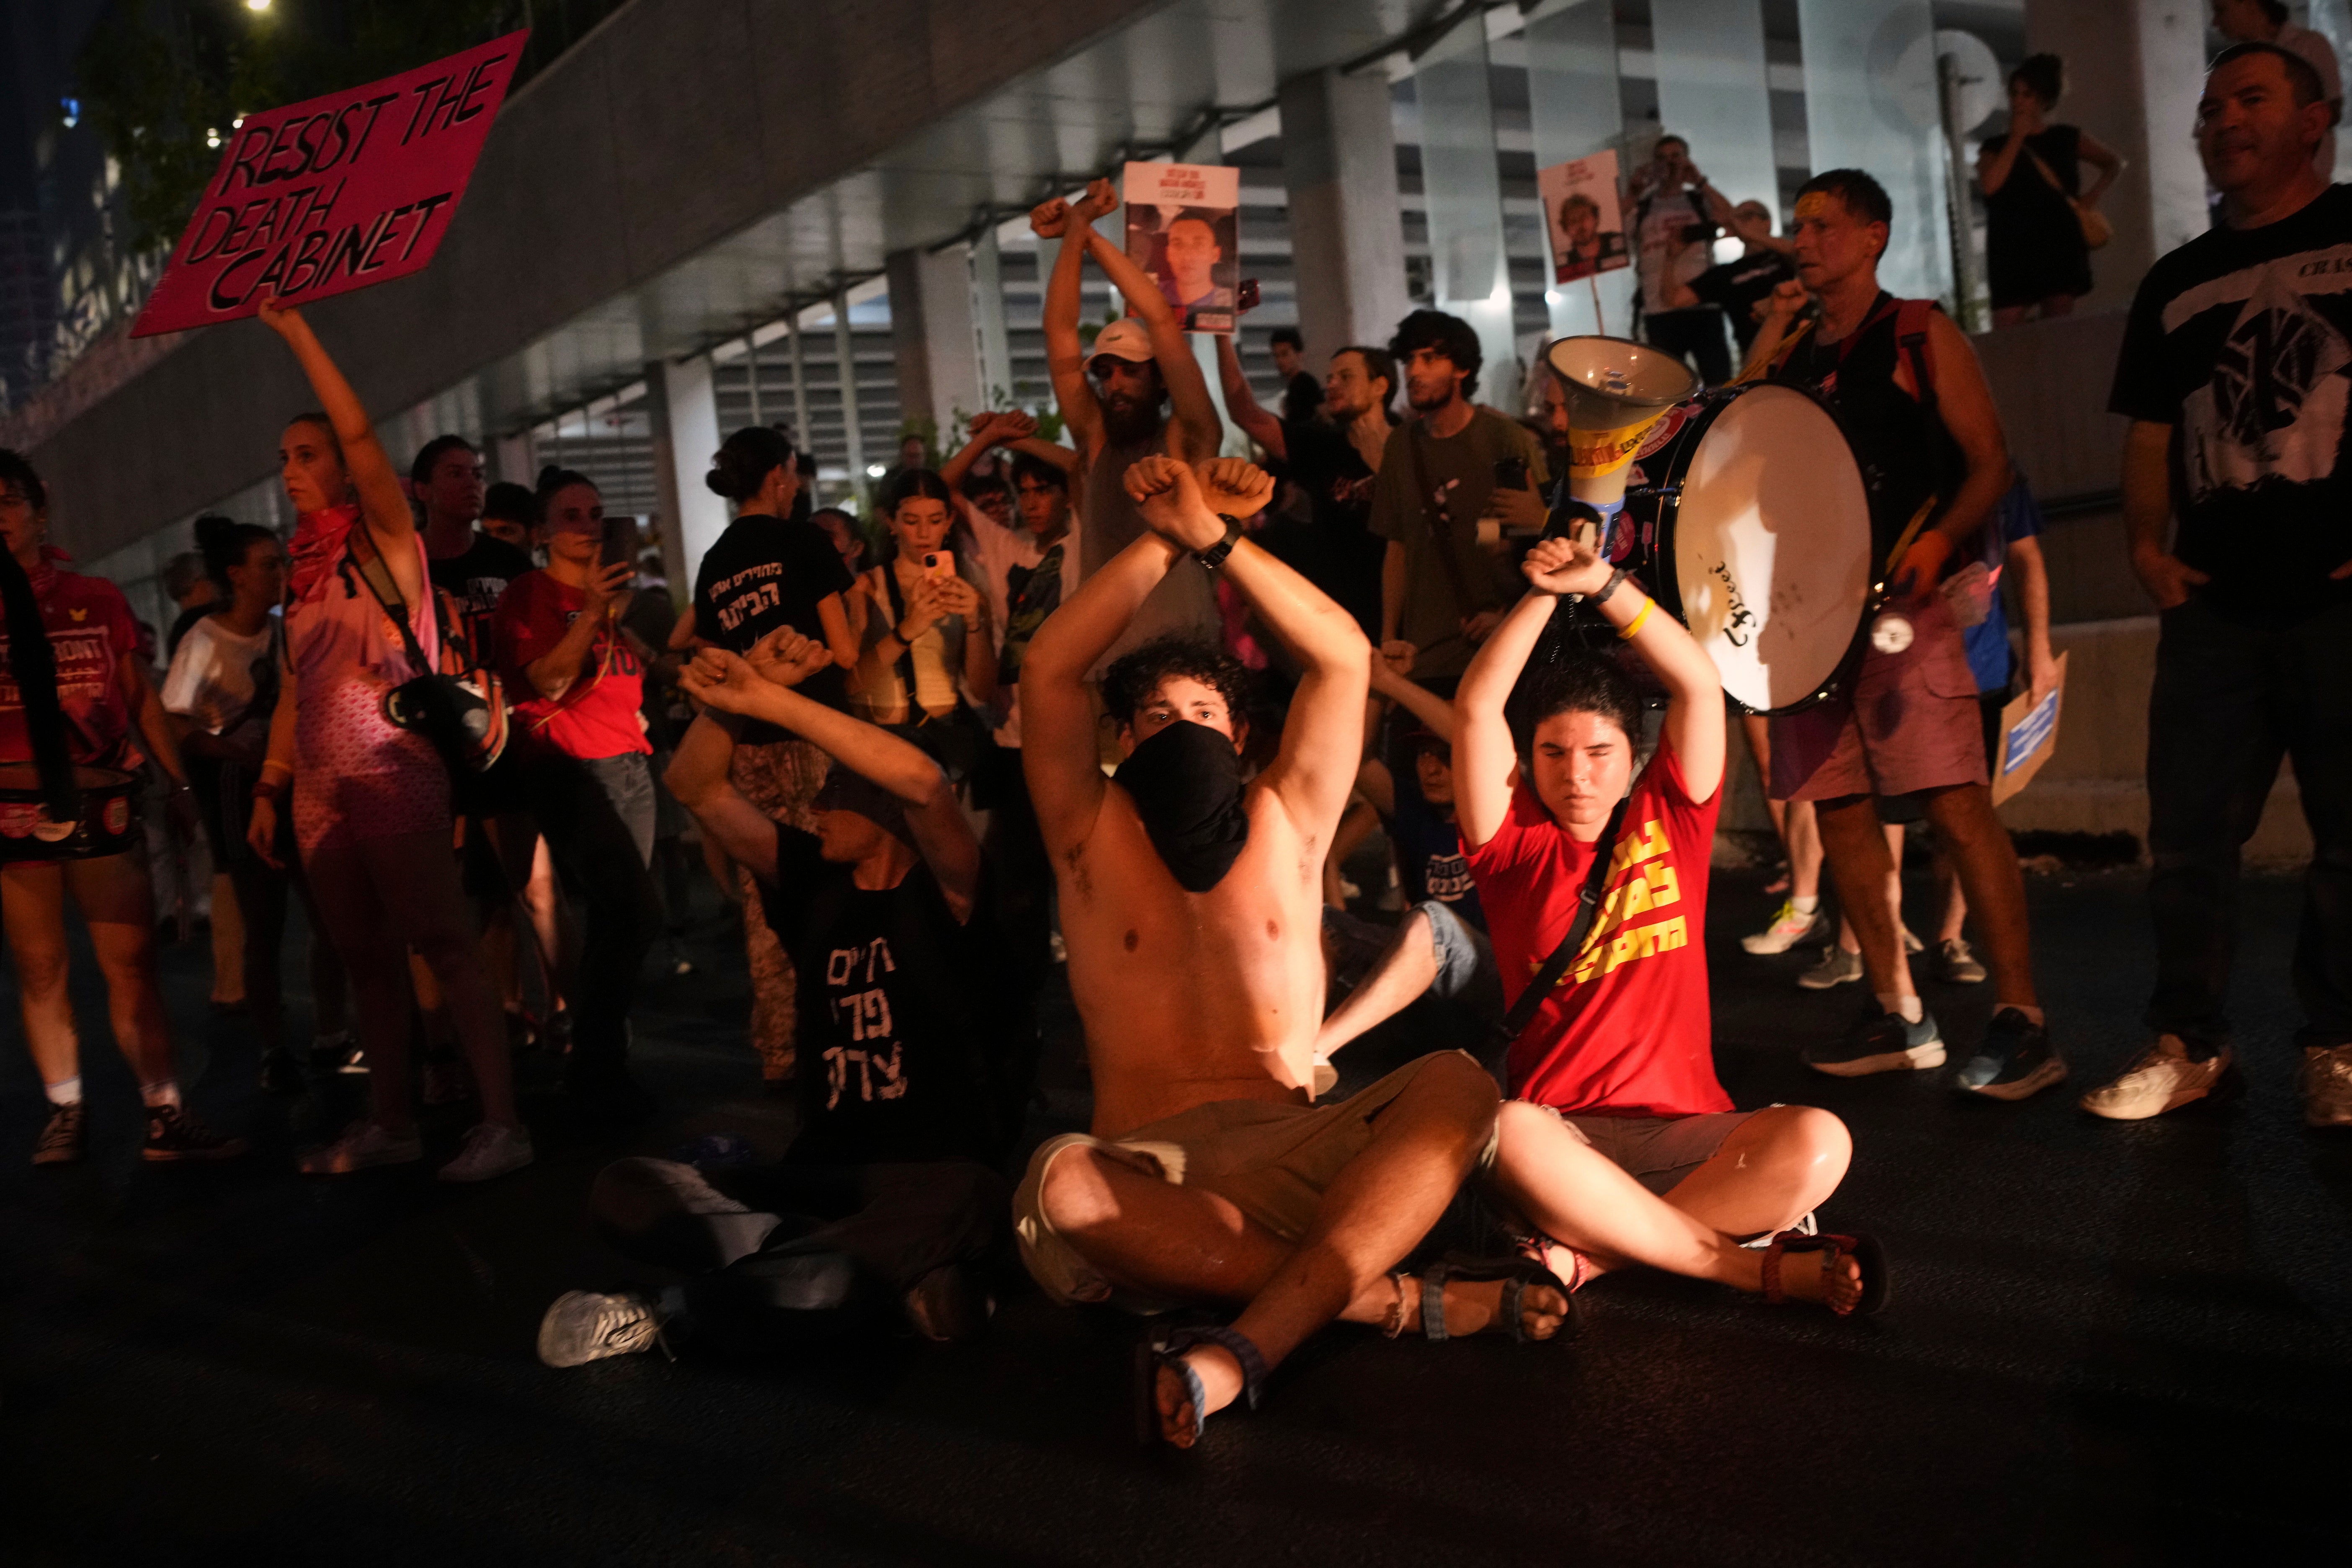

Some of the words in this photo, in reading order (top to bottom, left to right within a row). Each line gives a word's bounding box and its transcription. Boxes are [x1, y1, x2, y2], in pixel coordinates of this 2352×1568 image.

[217, 93, 400, 197] RESIST
[400, 53, 509, 146] THE
[186, 178, 346, 265] DEATH
[211, 192, 452, 309] CABINET
